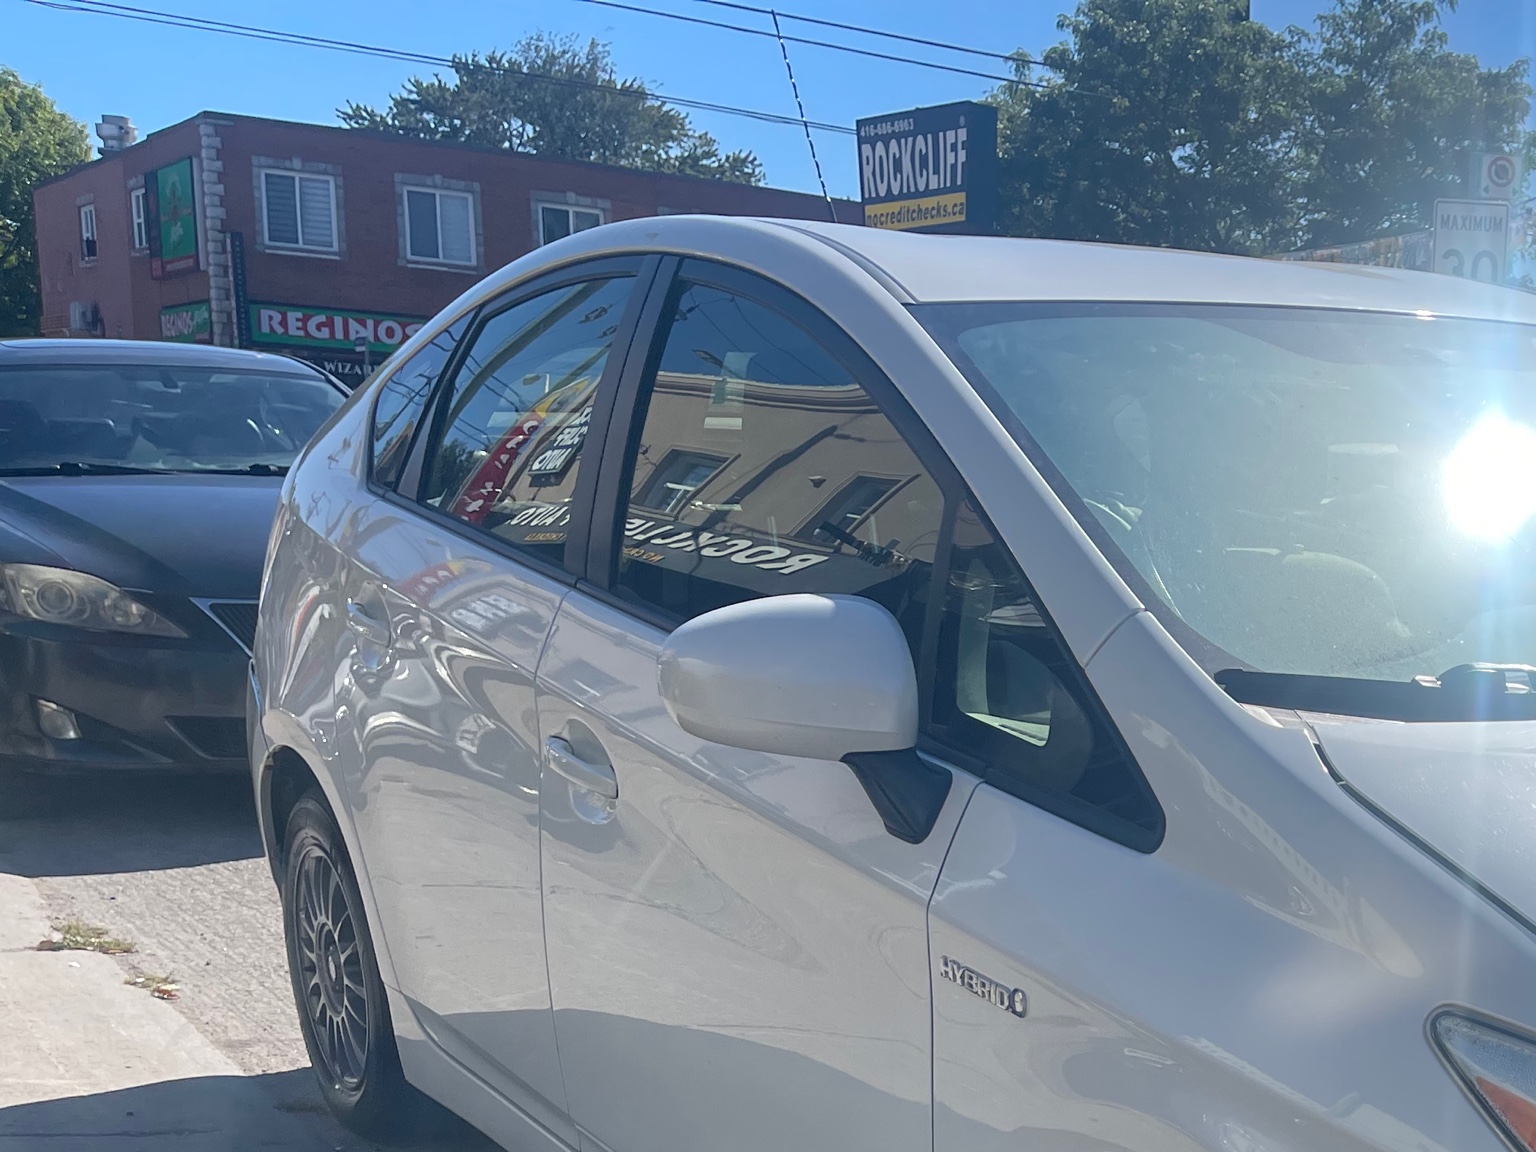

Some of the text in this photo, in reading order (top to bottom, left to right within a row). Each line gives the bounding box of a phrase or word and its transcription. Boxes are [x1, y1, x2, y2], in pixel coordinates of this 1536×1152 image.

[860, 127, 967, 199] ROCKCLIFF
[866, 201, 965, 228] nocreditchecks.ca
[1441, 213, 1503, 233] MAXIMUM
[1442, 248, 1499, 283] 30
[940, 954, 1012, 1011] HYBRID
